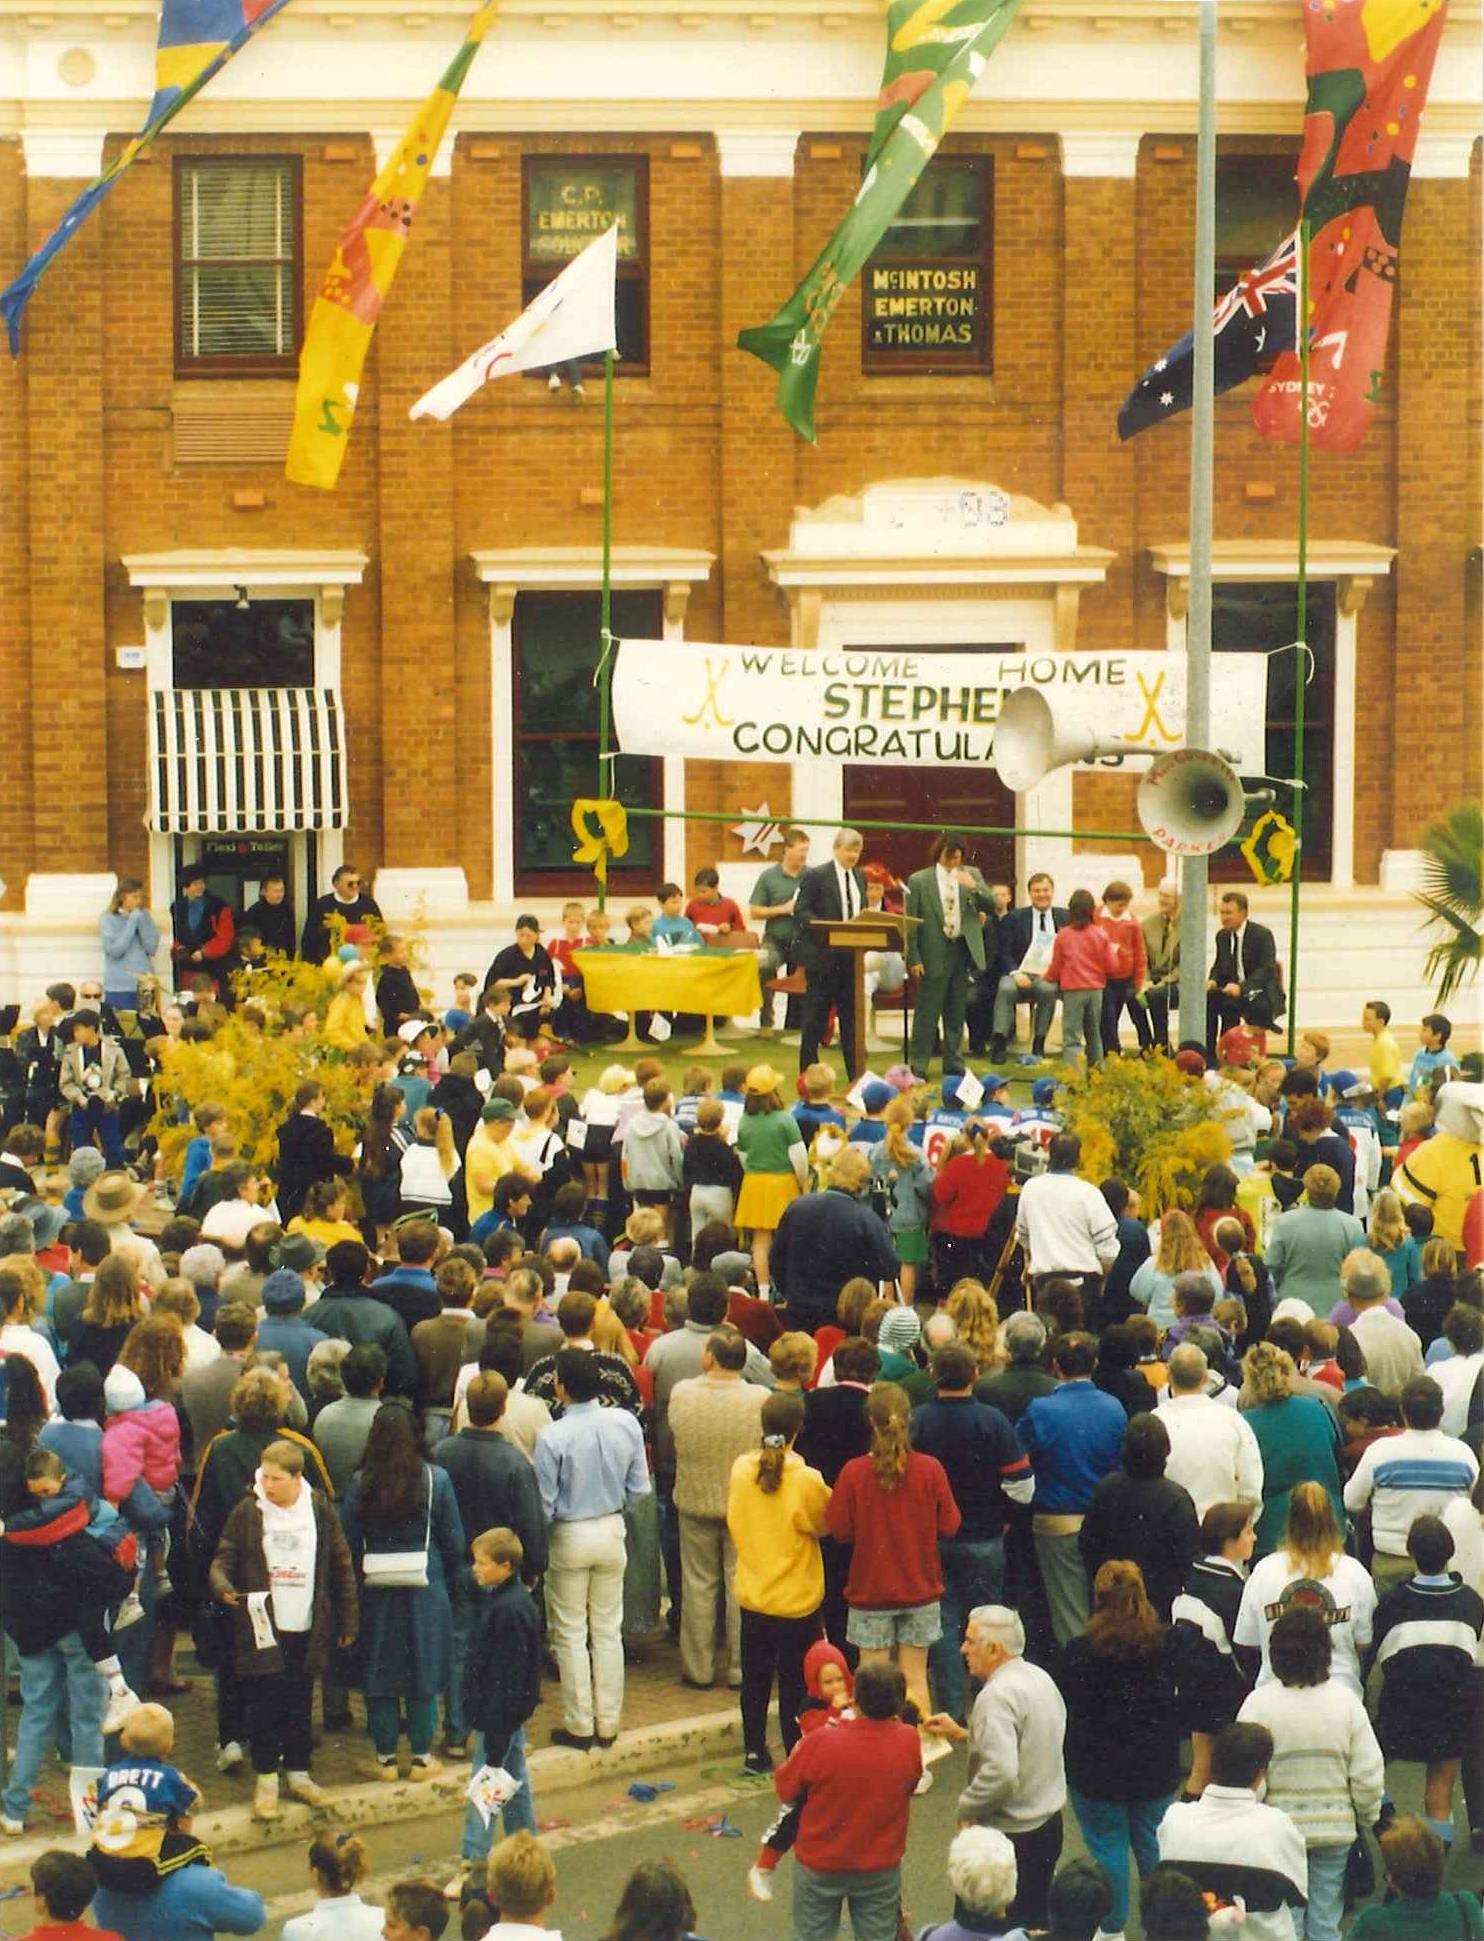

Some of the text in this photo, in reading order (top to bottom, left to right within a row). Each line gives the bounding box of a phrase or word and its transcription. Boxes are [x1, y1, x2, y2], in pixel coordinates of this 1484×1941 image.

[538, 210, 627, 229] EMERTON
[874, 297, 974, 317] EMERTON
[884, 324, 972, 343] THOMAS
[741, 652, 1127, 685] WELCOME HOME
[823, 682, 1012, 723] STEPHE
